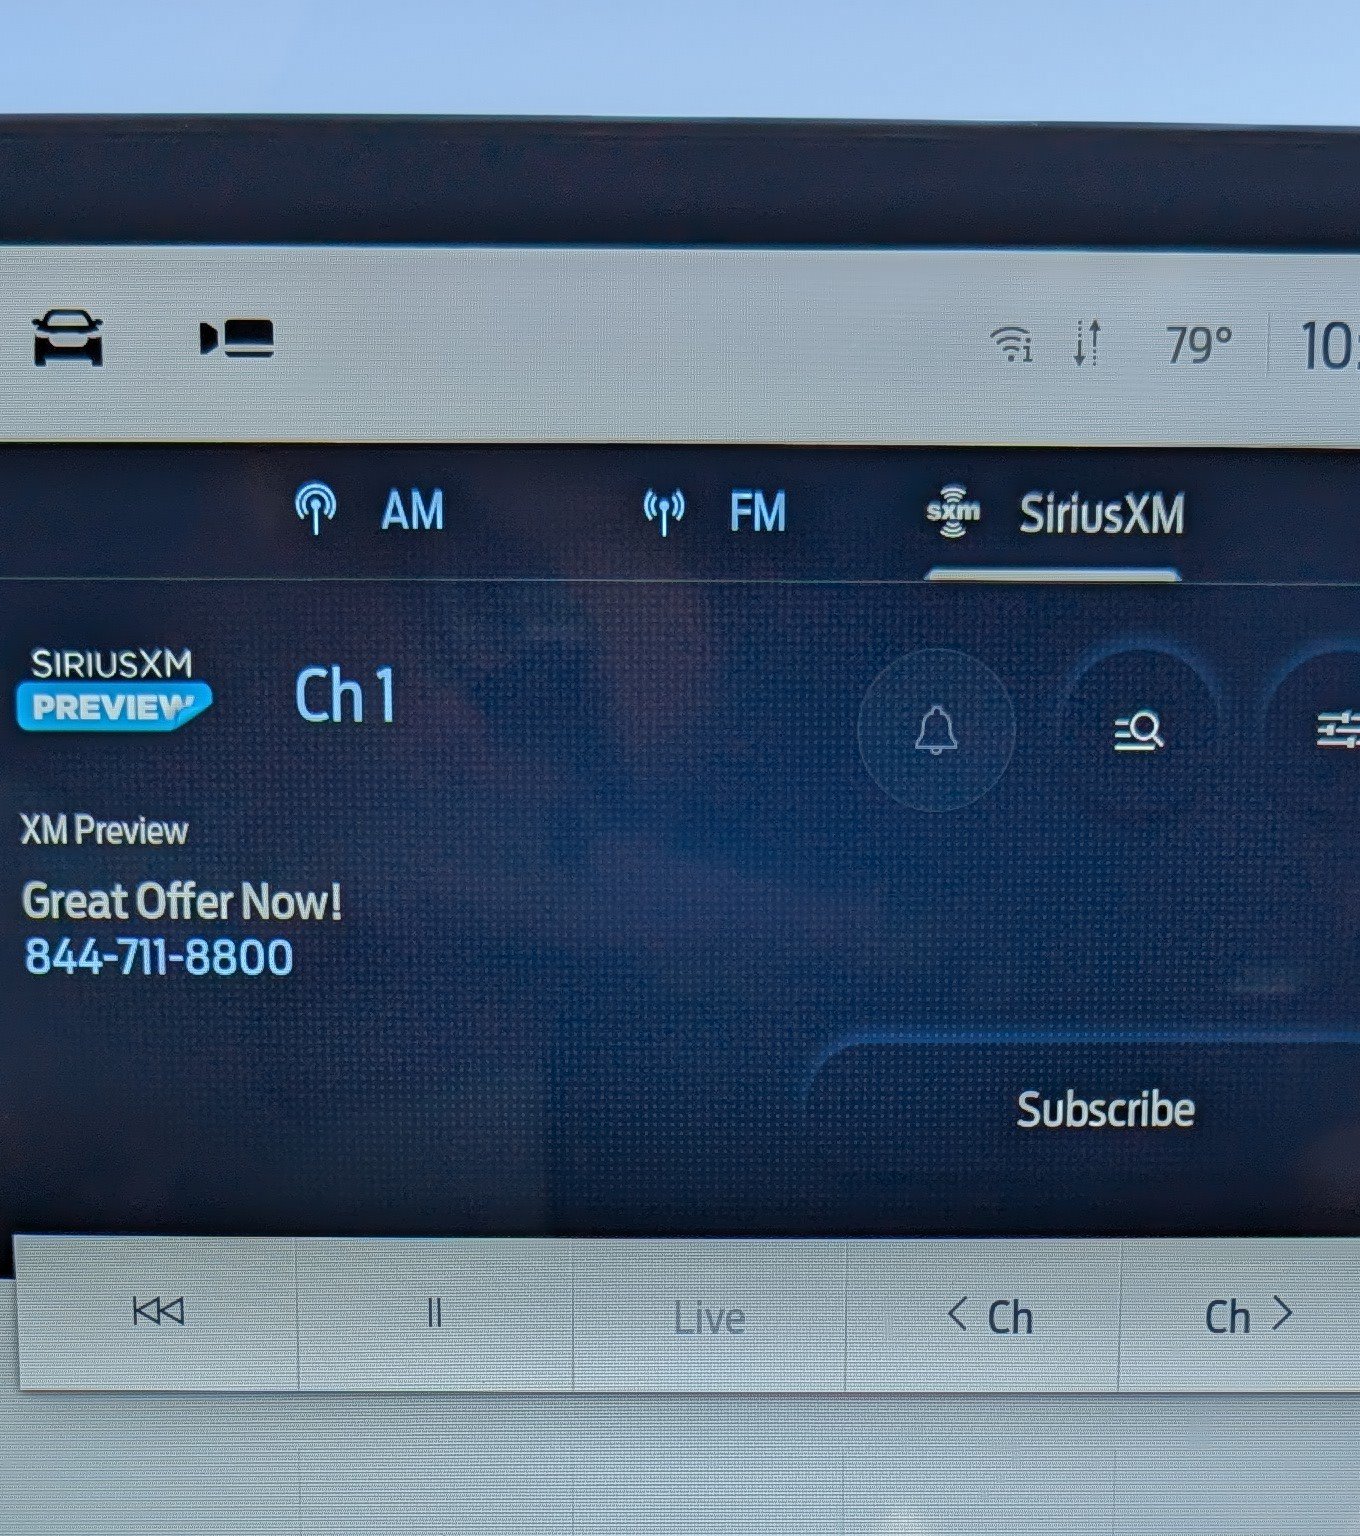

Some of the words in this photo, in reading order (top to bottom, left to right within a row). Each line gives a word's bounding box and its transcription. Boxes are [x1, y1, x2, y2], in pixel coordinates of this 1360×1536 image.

[381, 489, 444, 530] AM
[730, 490, 786, 532] FM
[1019, 492, 1185, 534] SiriusXM
[32, 648, 192, 679] SIRIUSXM
[32, 693, 195, 721] PREVIEW
[295, 664, 363, 723] Ch
[376, 667, 393, 723] 1
[20, 813, 68, 845] XM
[74, 812, 190, 845] Preview
[22, 880, 130, 920] Great
[135, 879, 235, 920] Offer
[241, 881, 342, 921] Now!
[25, 937, 293, 976] 844-711-8800
[1017, 1088, 1196, 1128] Subscribe
[674, 1299, 746, 1335] Live
[988, 1298, 1033, 1335] Ch
[1205, 1297, 1251, 1334] Ch
